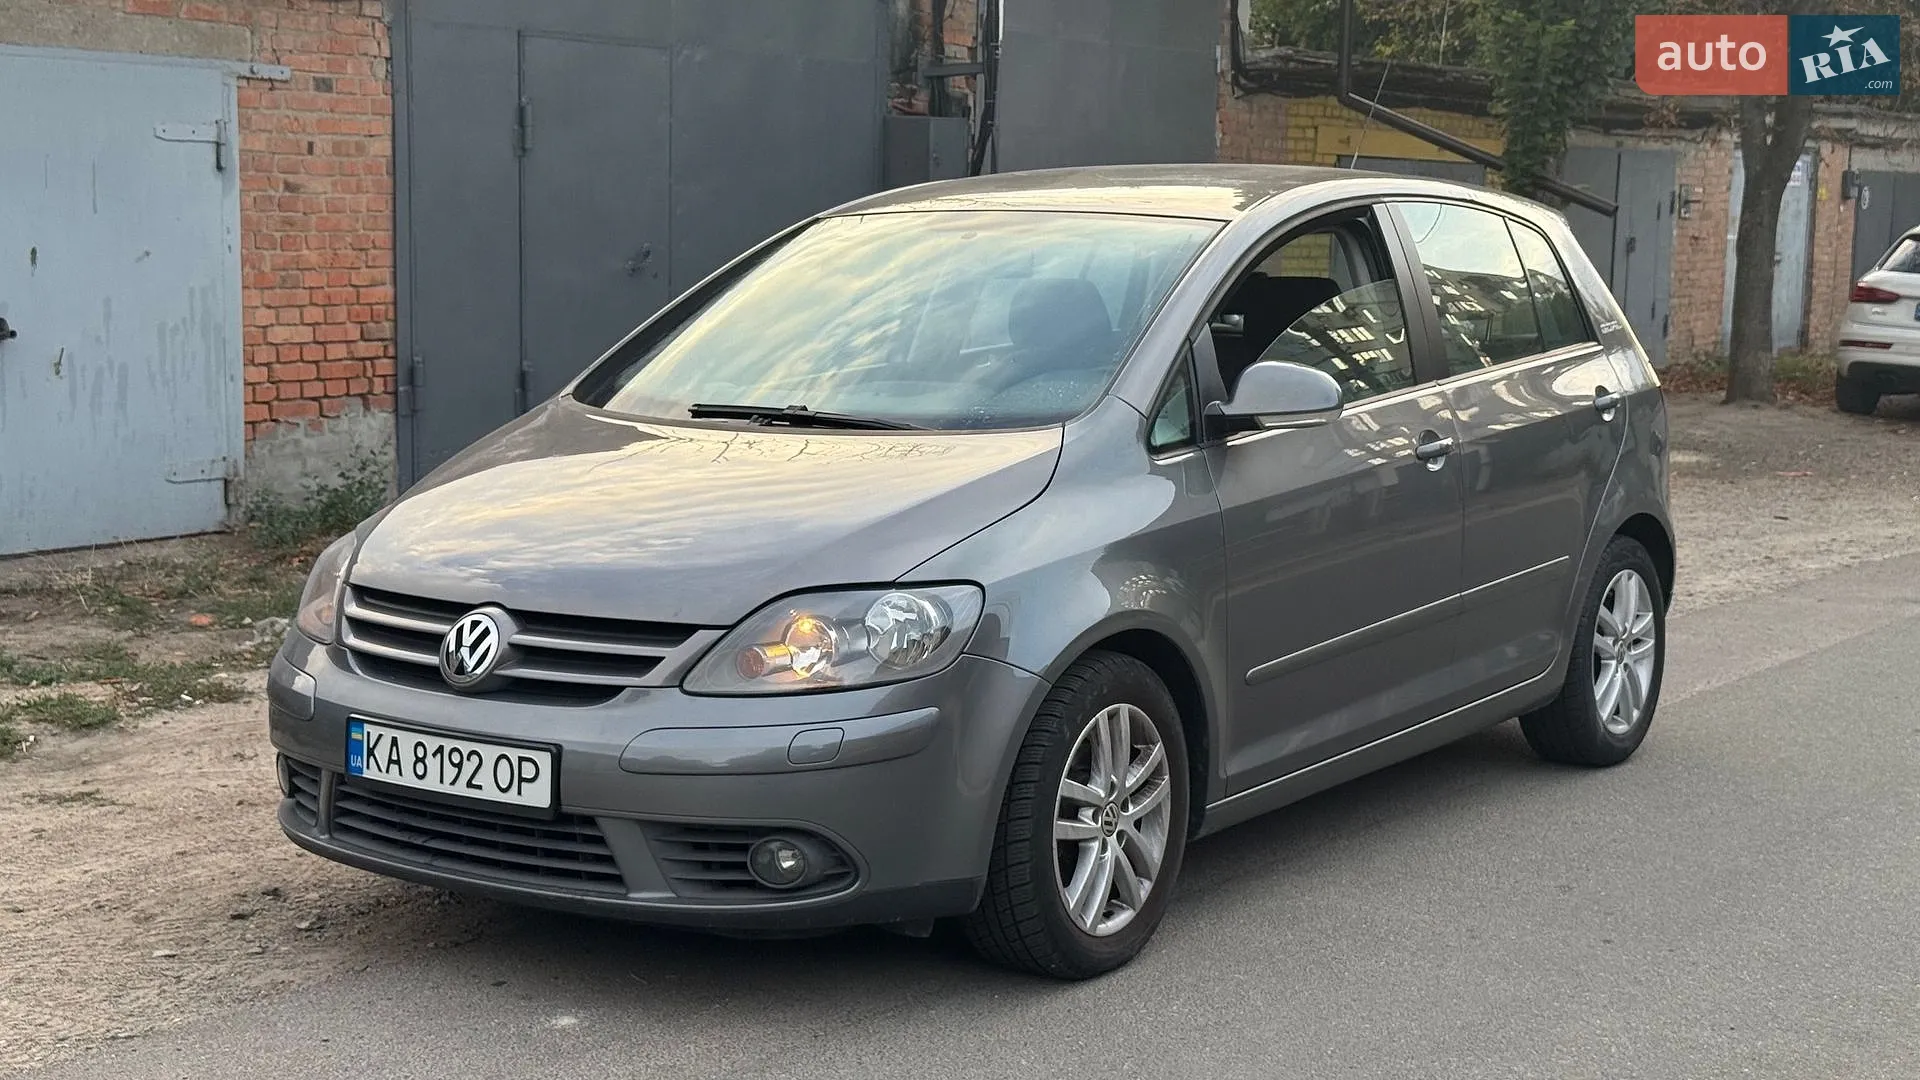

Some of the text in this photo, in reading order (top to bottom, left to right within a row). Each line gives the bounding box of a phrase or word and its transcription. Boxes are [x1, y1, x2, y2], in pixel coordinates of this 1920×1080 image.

[351, 754, 362, 769] UA
[366, 730, 540, 796] KA 8192 OP
